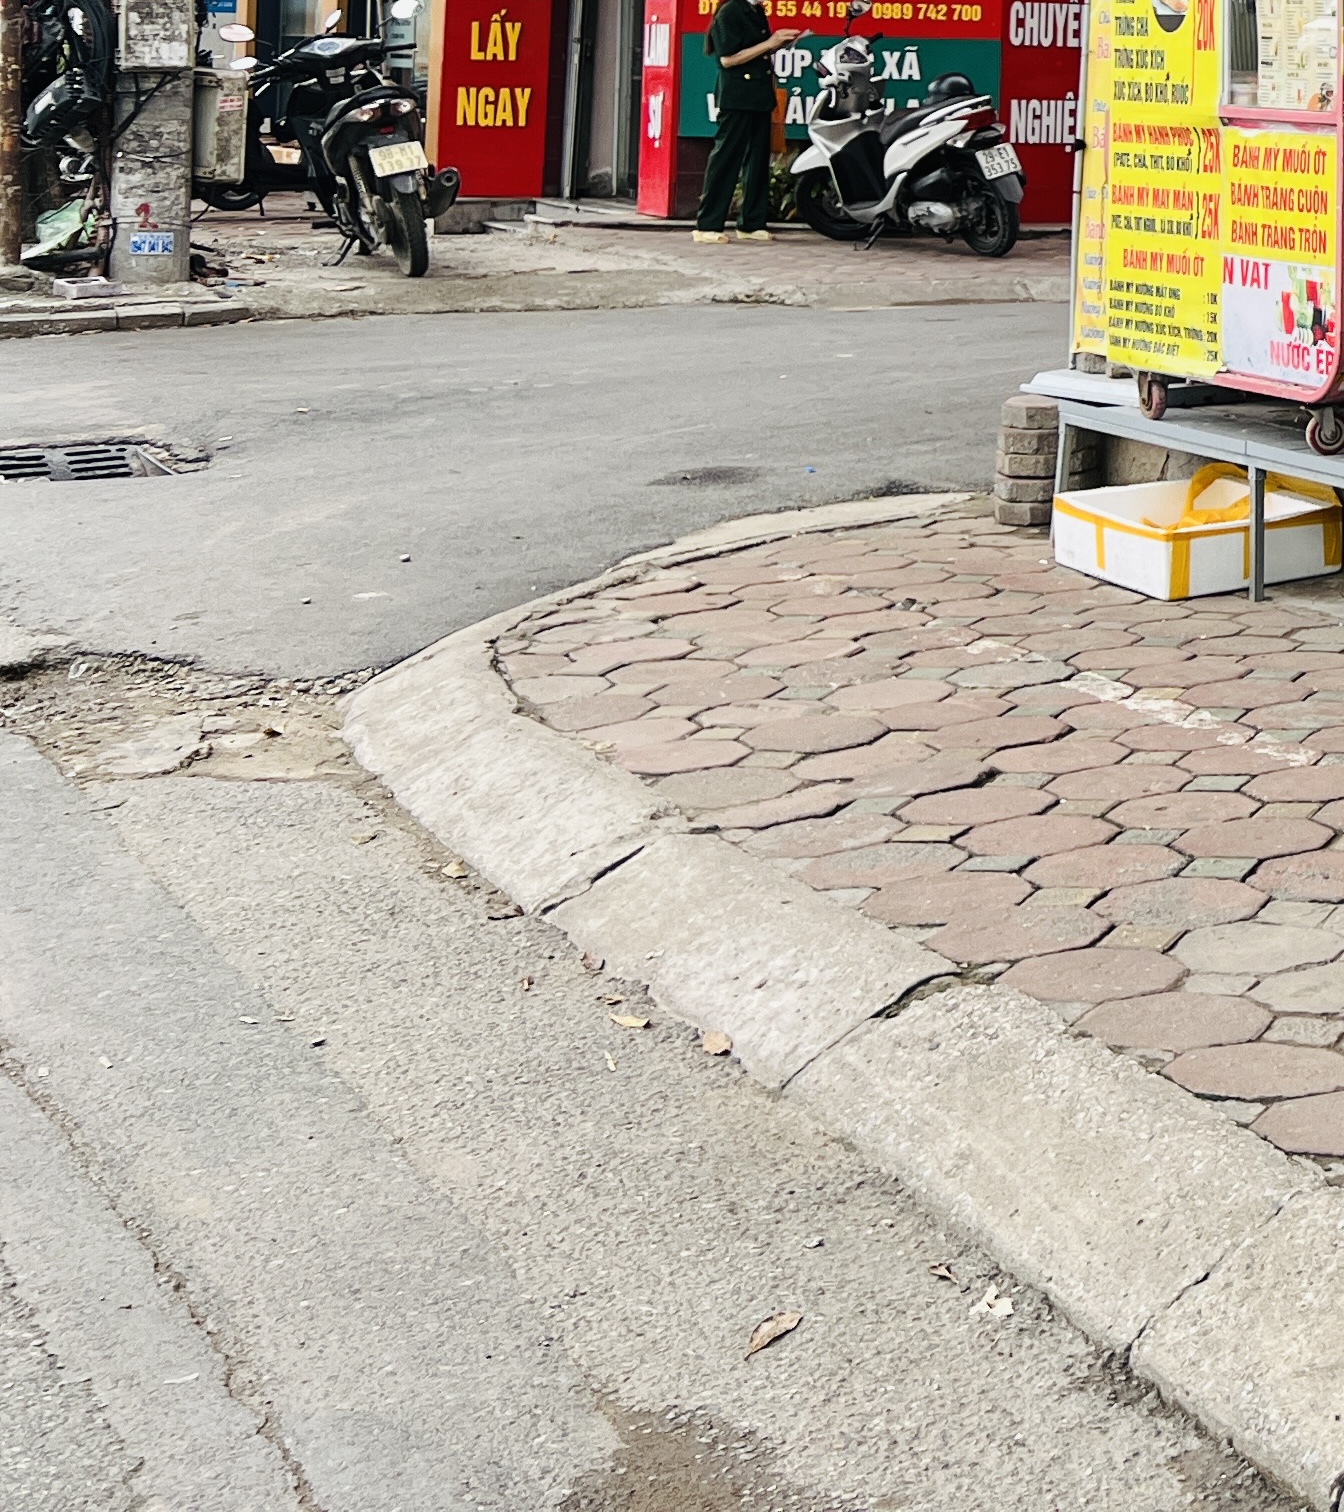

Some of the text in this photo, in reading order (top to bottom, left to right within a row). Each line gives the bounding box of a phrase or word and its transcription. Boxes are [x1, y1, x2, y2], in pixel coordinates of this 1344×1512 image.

[776, 1, 981, 21] 55 44 0989 742 700
[471, 13, 521, 63] LẤY
[881, 45, 921, 81] XÃ
[456, 86, 531, 128] NGAY
[1010, 91, 1078, 151] NGHIỆ
[1201, 127, 1221, 174] 25K
[1232, 140, 1327, 176] BÁNH MỲ MUỐI ỚT
[1201, 193, 1221, 240] 25K
[1231, 178, 1328, 221] BÁNH TRÁNG CUỘN
[1231, 214, 1258, 246] BÁNH
[1261, 219, 1295, 252] TRÁNG
[1298, 223, 1327, 261] TRỘN
[1123, 245, 1148, 270] BÁNH
[1150, 248, 1164, 273] MỲ
[1166, 248, 1190, 276] MUỐI
[1269, 340, 1312, 373] NƯỚC
